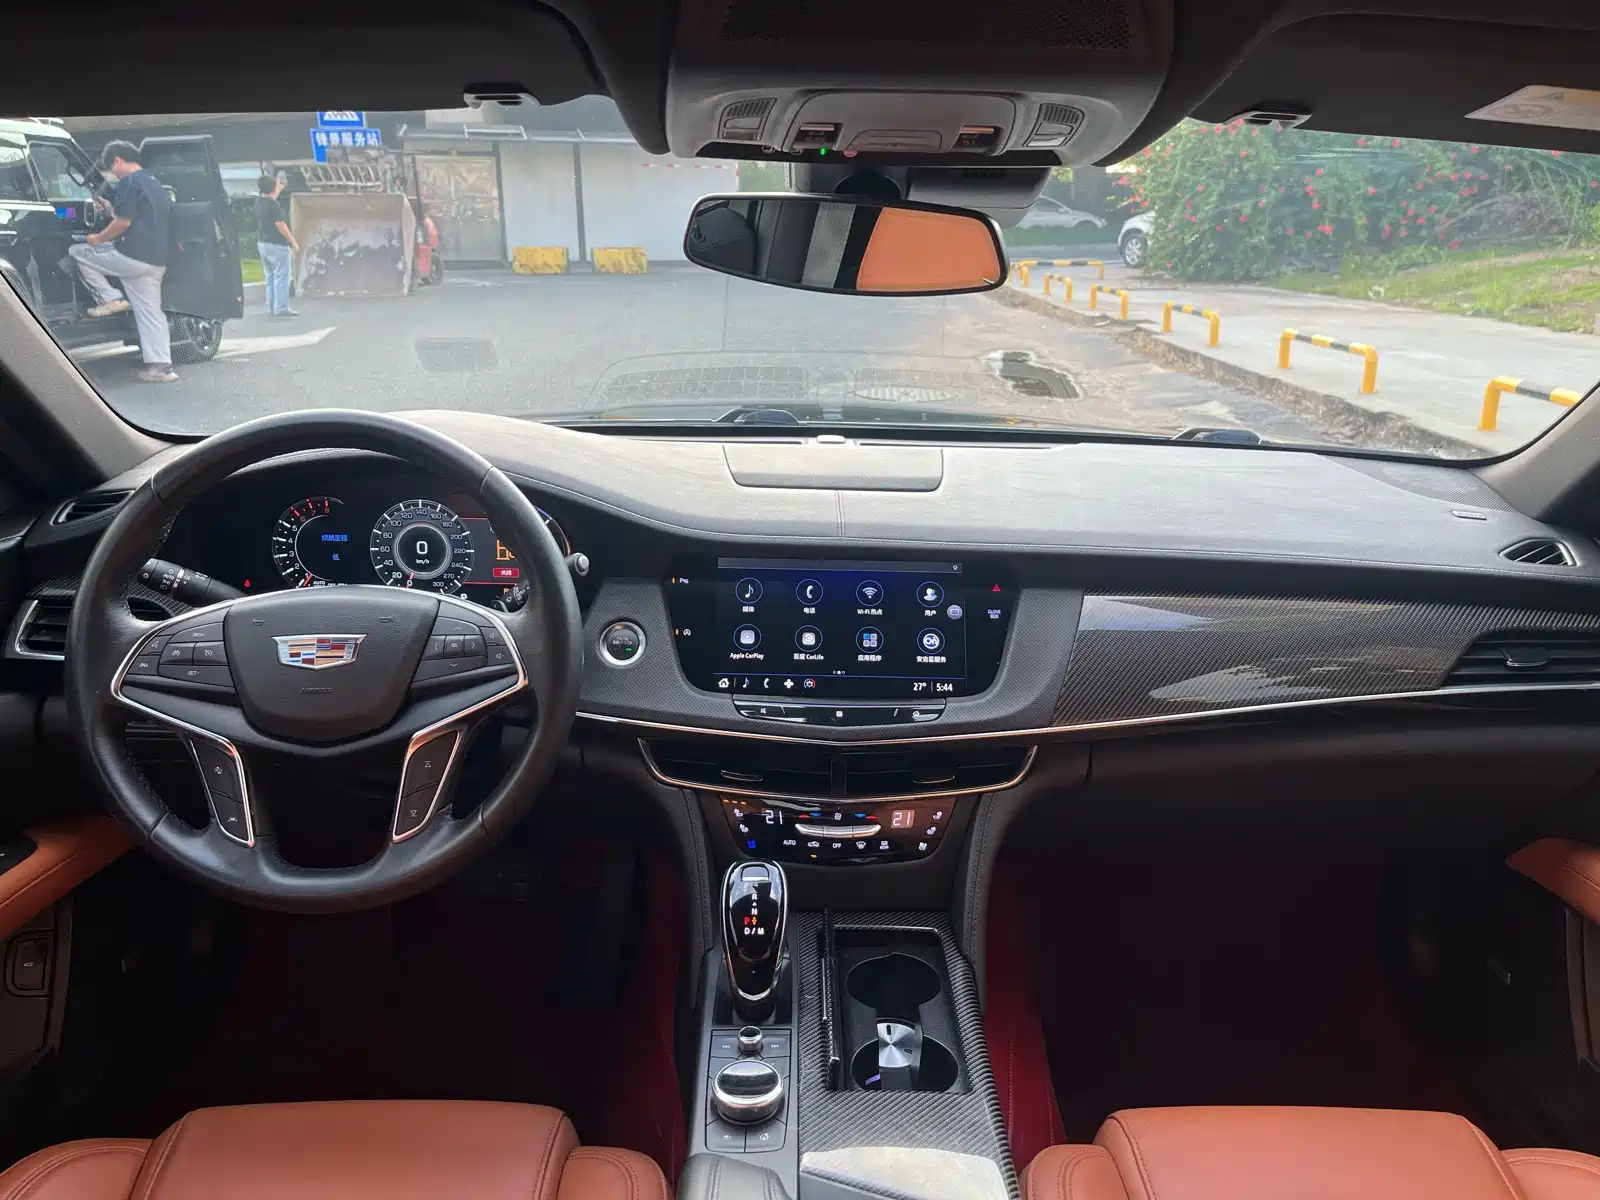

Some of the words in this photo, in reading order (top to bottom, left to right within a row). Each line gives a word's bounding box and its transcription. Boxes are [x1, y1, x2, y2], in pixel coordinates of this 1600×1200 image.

[416, 540, 428, 554] 0
[729, 652, 745, 660] Apple
[857, 654, 882, 662] 应用程序
[913, 682, 926, 691] 27°
[936, 683, 953, 691] 5:44
[765, 810, 783, 825] 21
[892, 811, 910, 826] 21
[744, 917, 751, 925] P
